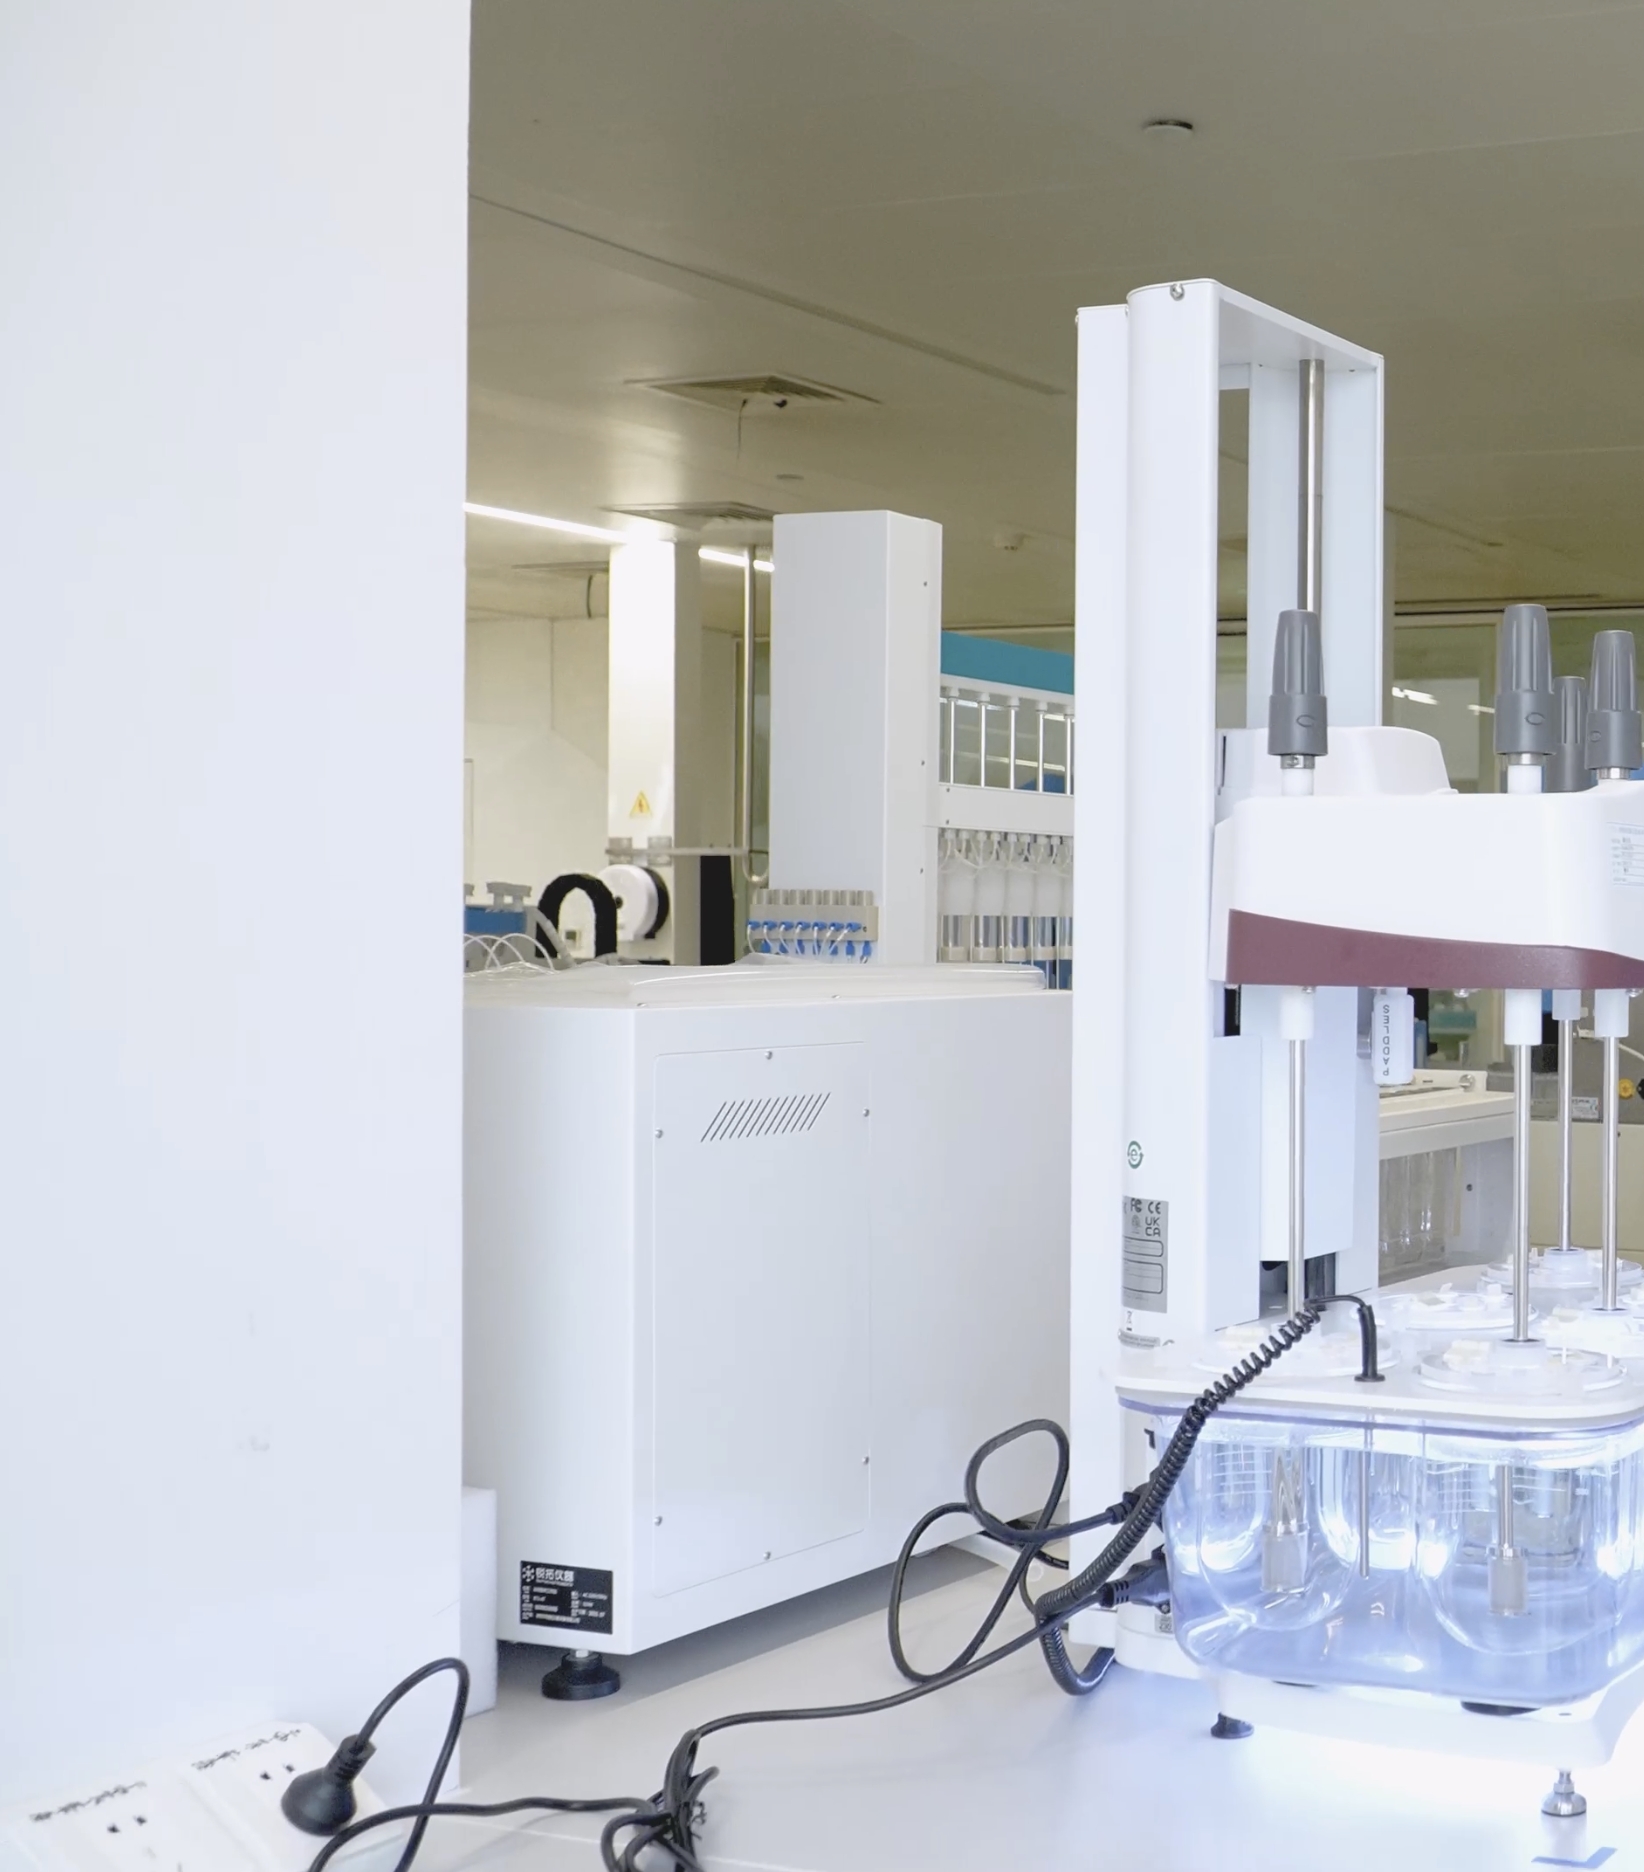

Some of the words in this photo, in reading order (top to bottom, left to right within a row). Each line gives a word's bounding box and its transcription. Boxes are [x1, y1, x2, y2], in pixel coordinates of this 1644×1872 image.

[1382, 1004, 1390, 1076] PADDLES
[1147, 1201, 1161, 1215] CE
[1145, 1216, 1160, 1227] UK
[1145, 1226, 1161, 1237] CA
